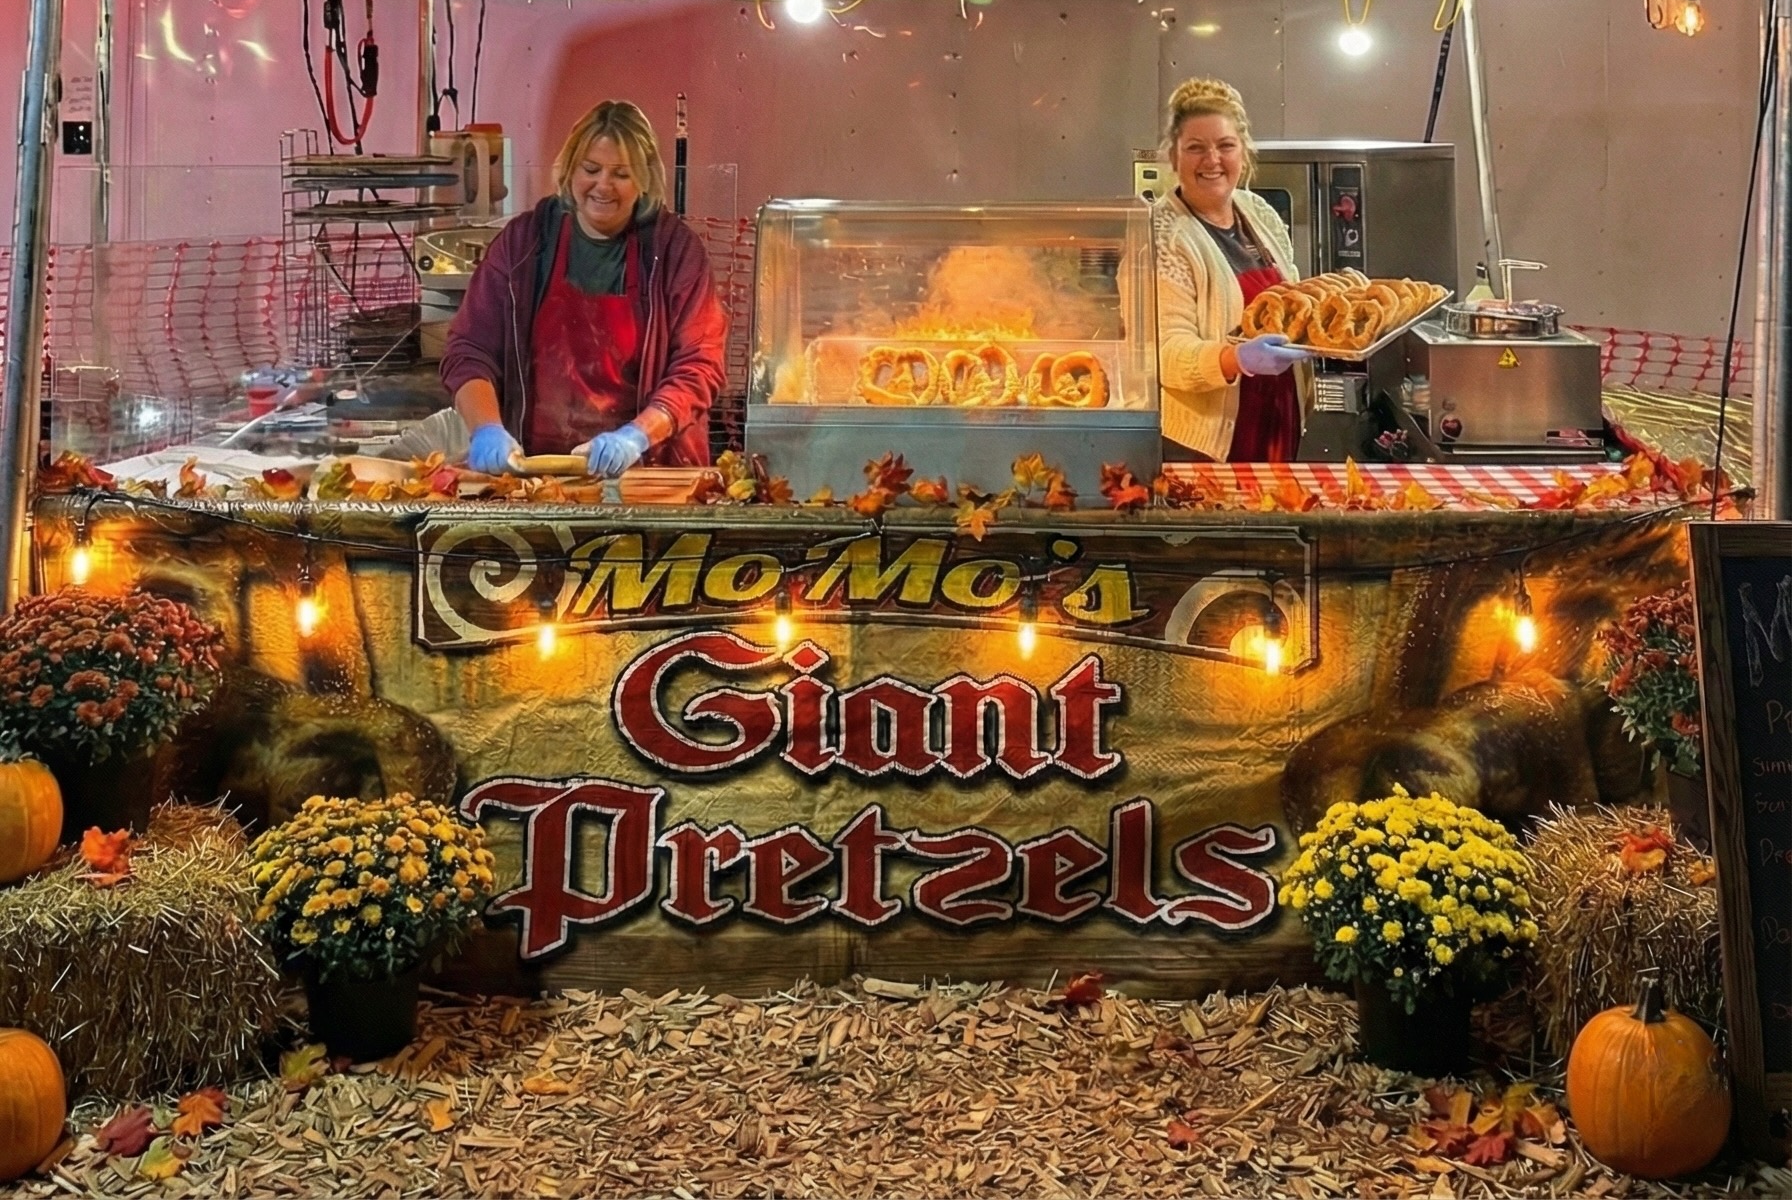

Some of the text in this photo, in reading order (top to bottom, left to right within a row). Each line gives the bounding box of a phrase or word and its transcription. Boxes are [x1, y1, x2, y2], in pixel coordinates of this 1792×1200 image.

[570, 531, 1155, 626] MoMo's
[611, 630, 1124, 780] Giant
[459, 775, 1280, 962] Pretzels
